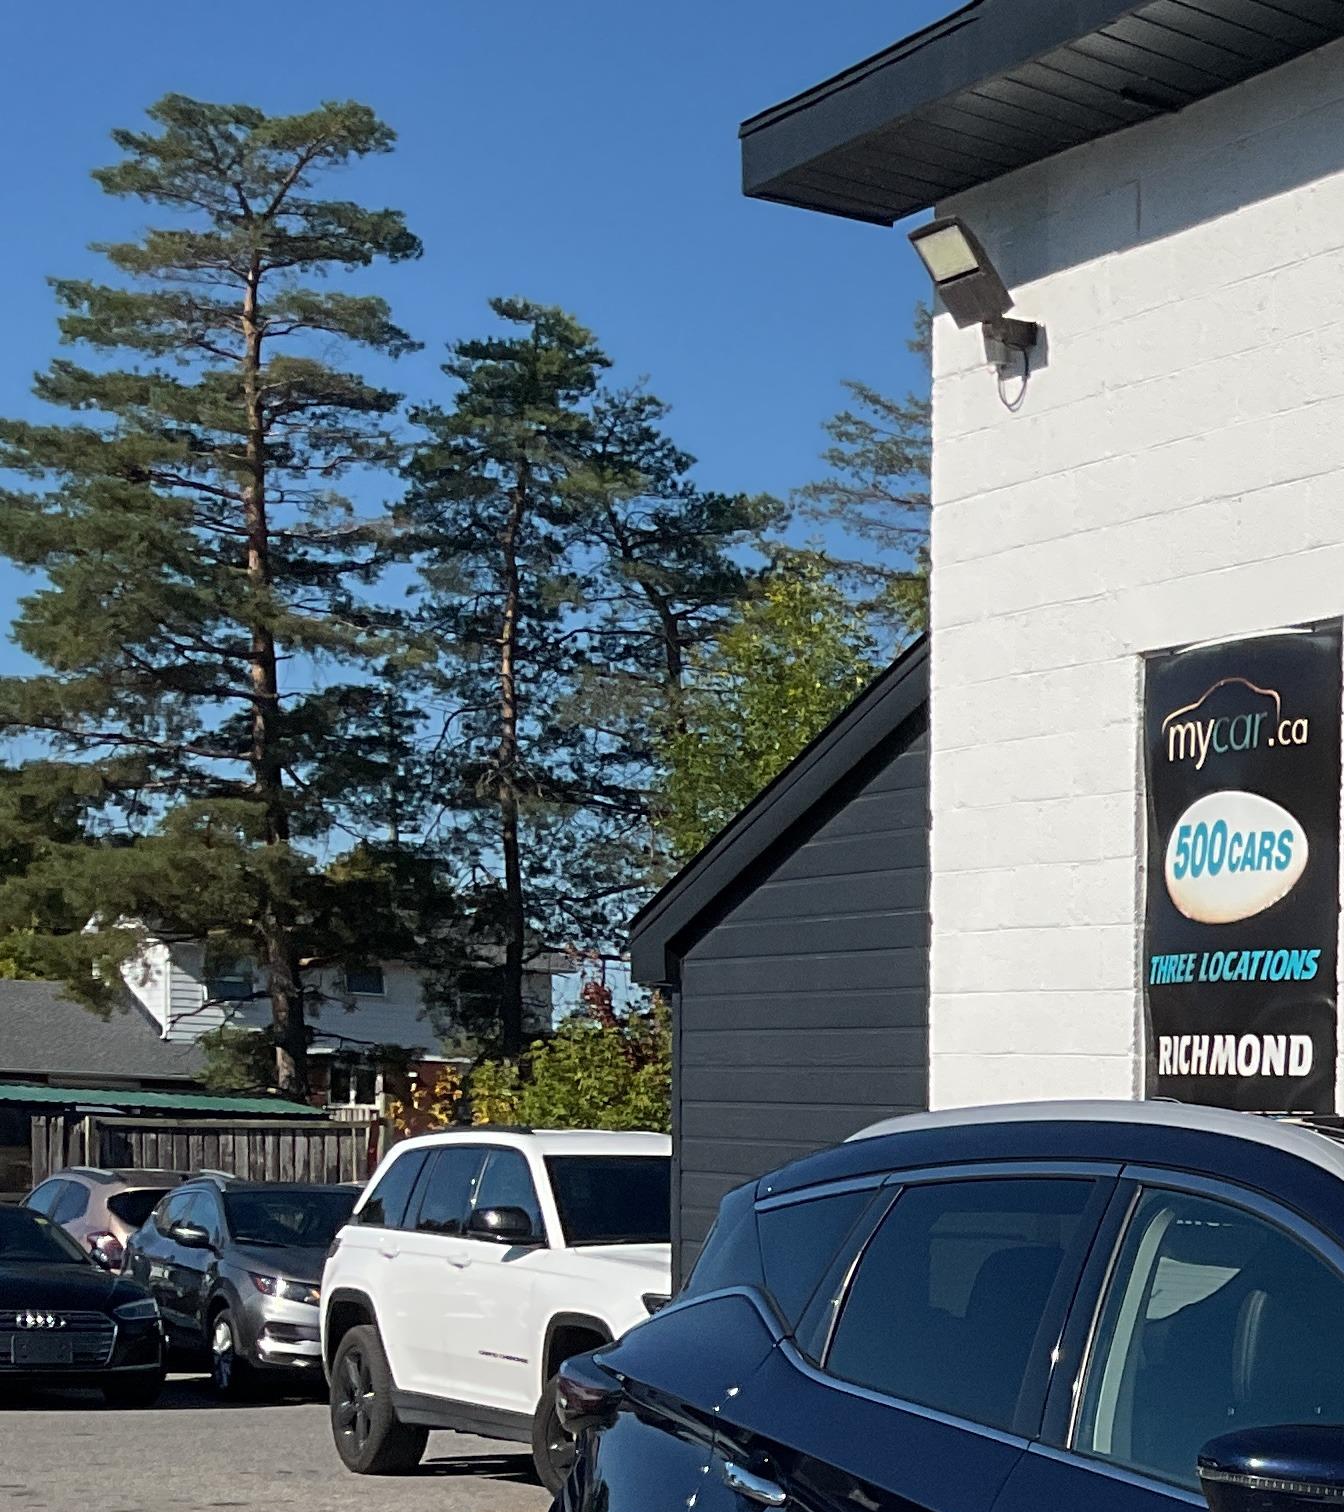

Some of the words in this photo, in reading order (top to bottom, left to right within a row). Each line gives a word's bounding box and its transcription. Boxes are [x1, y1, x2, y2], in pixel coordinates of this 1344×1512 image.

[1168, 712, 1309, 770] mycar.ca
[1149, 953, 1198, 985] THREE
[1199, 949, 1322, 982] LOCATIONS
[1158, 1034, 1314, 1077] RICHMOND
